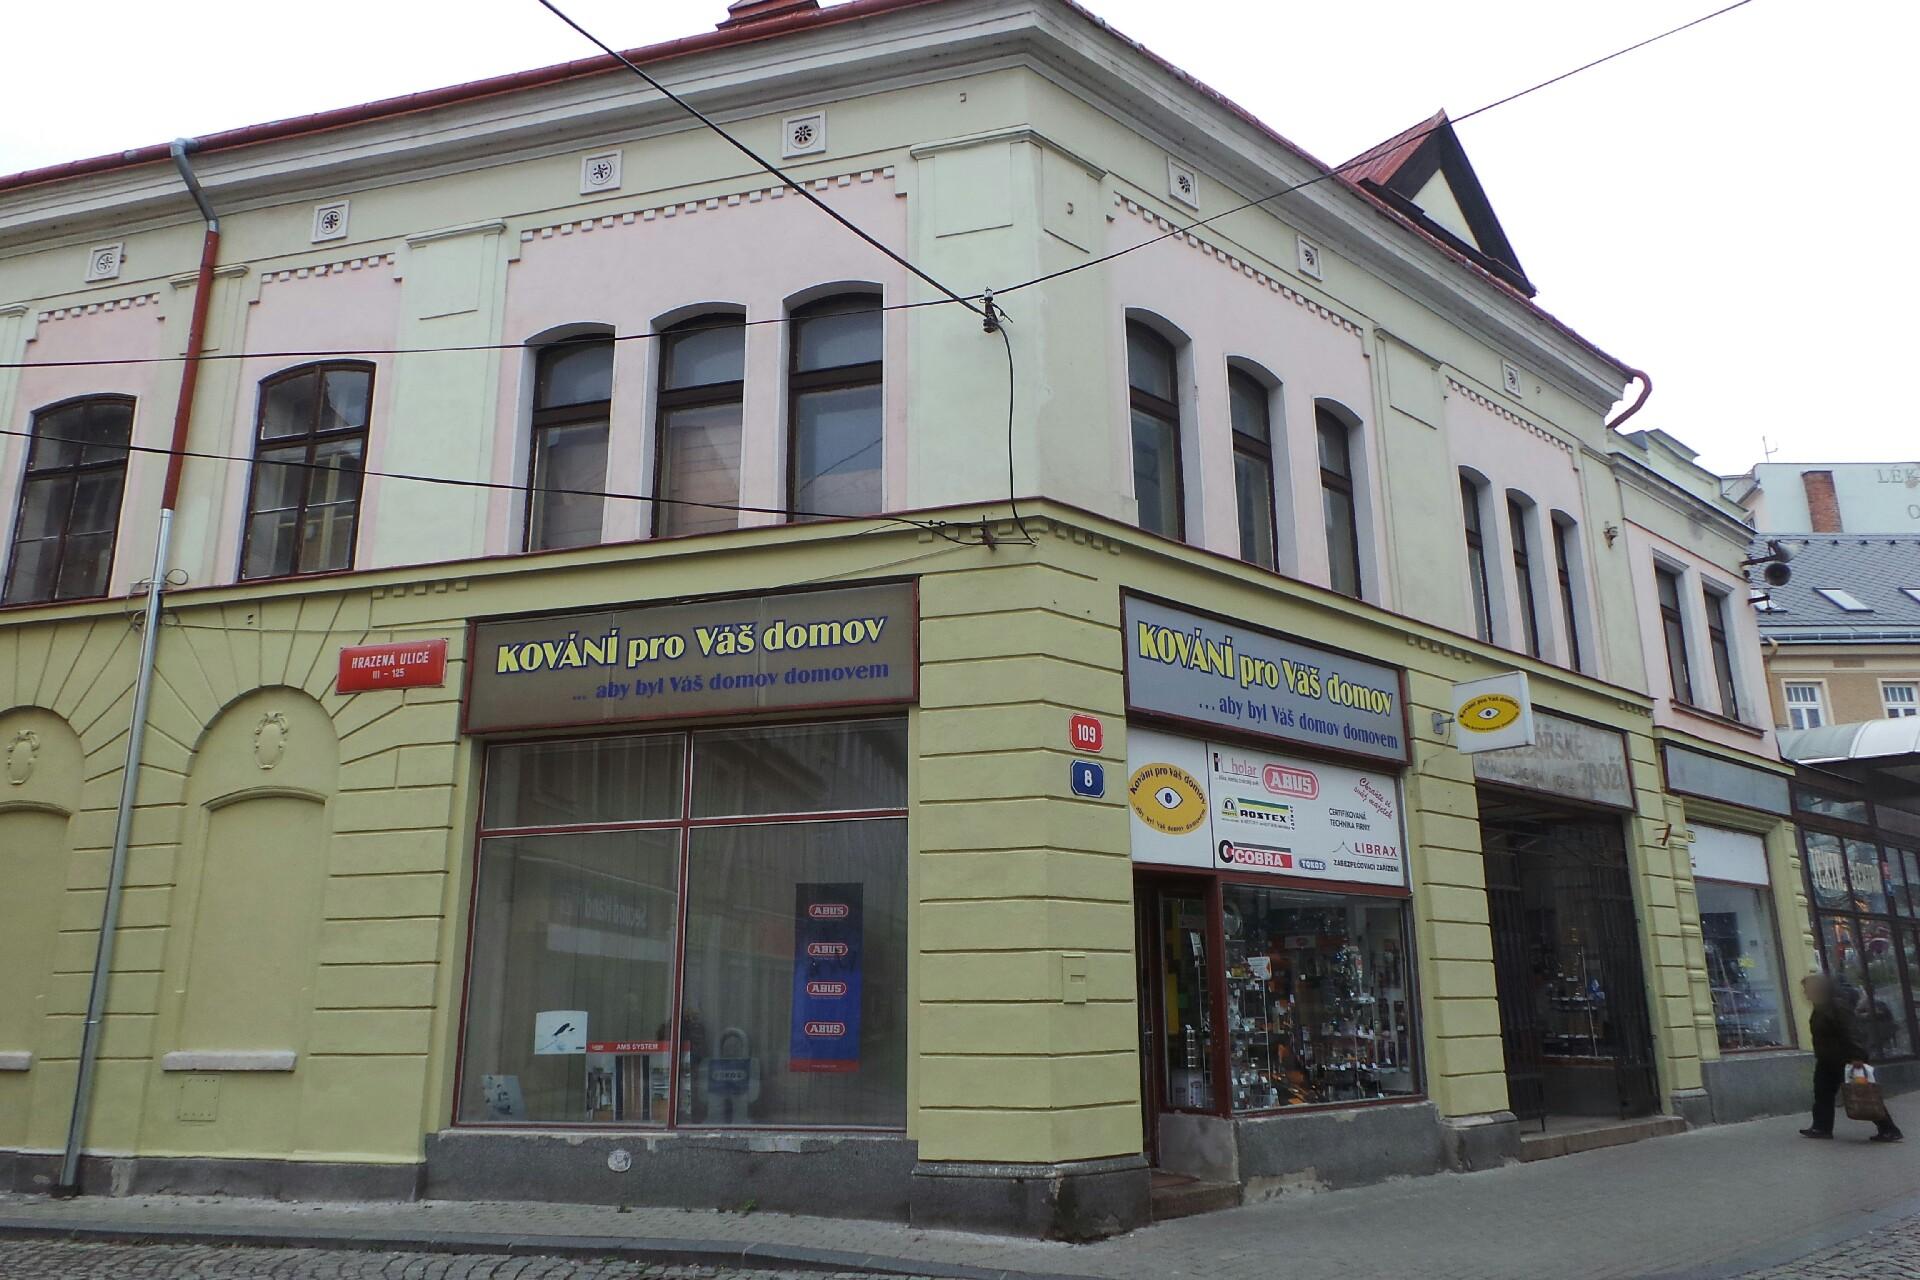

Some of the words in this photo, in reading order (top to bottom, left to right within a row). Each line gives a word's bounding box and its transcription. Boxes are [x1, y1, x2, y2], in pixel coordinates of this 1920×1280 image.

[497, 627, 620, 674] KOVÁNÍ
[626, 634, 687, 670] pro
[693, 621, 757, 658] Váš
[762, 615, 888, 652] domov
[400, 651, 430, 665] ULICE
[391, 668, 405, 679] 125
[1137, 620, 1235, 680] KOVÁNÍ
[1239, 653, 1280, 690] pro
[1280, 658, 1322, 700] Váš
[1327, 671, 1393, 717] domov
[596, 681, 631, 701] aby
[635, 677, 664, 700] byl
[670, 674, 703, 692] Váš
[709, 671, 779, 691] domov
[784, 663, 889, 684] domovem
[1248, 700, 1267, 724] byl
[1271, 705, 1295, 728] Váš
[1299, 712, 1339, 736] domov
[1343, 722, 1398, 749] domovem
[1077, 723, 1096, 743] 109
[1084, 769, 1093, 787] 8
[1154, 767, 1168, 778] pro
[1184, 775, 1207, 805] domov
[1271, 771, 1313, 793] ABUS
[1240, 809, 1287, 823] ROSTEX
[1330, 819, 1355, 829] TECHNIKA
[1354, 842, 1398, 857] LIBRAX
[1235, 850, 1284, 867] COBRA
[814, 906, 844, 915] ABUS
[812, 945, 843, 954] ABUS
[811, 984, 842, 993] ABUS
[810, 1024, 841, 1034] ABUS
